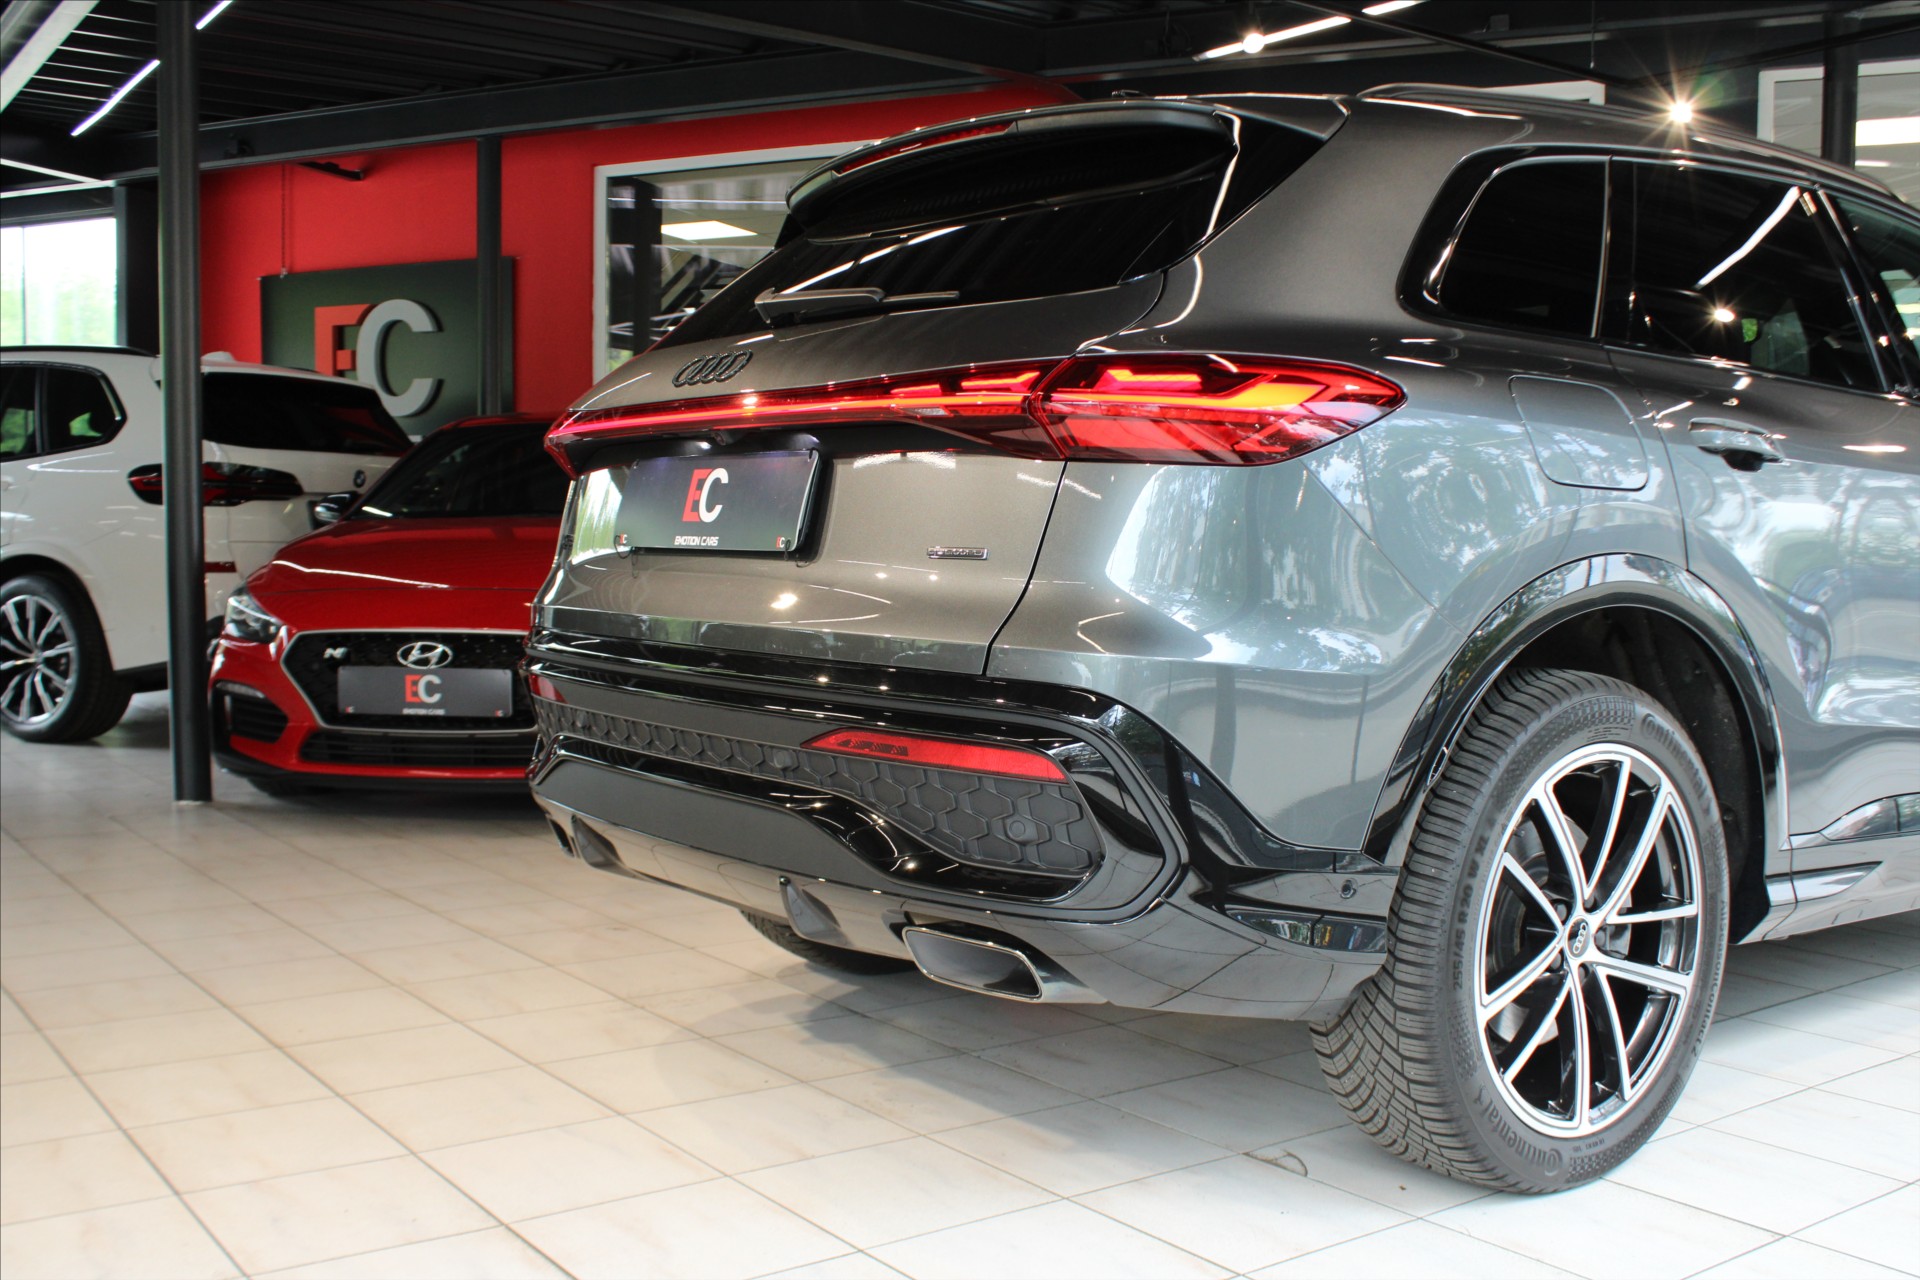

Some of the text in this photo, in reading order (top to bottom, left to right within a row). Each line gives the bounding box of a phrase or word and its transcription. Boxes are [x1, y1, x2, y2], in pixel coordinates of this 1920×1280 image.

[314, 299, 440, 417] EC
[682, 467, 729, 523] EC
[673, 535, 719, 547] EMOTION CARS
[776, 537, 786, 548] EC
[405, 674, 442, 704] EC
[1641, 713, 1708, 801] Continental
[1484, 1098, 1564, 1177] Continental
